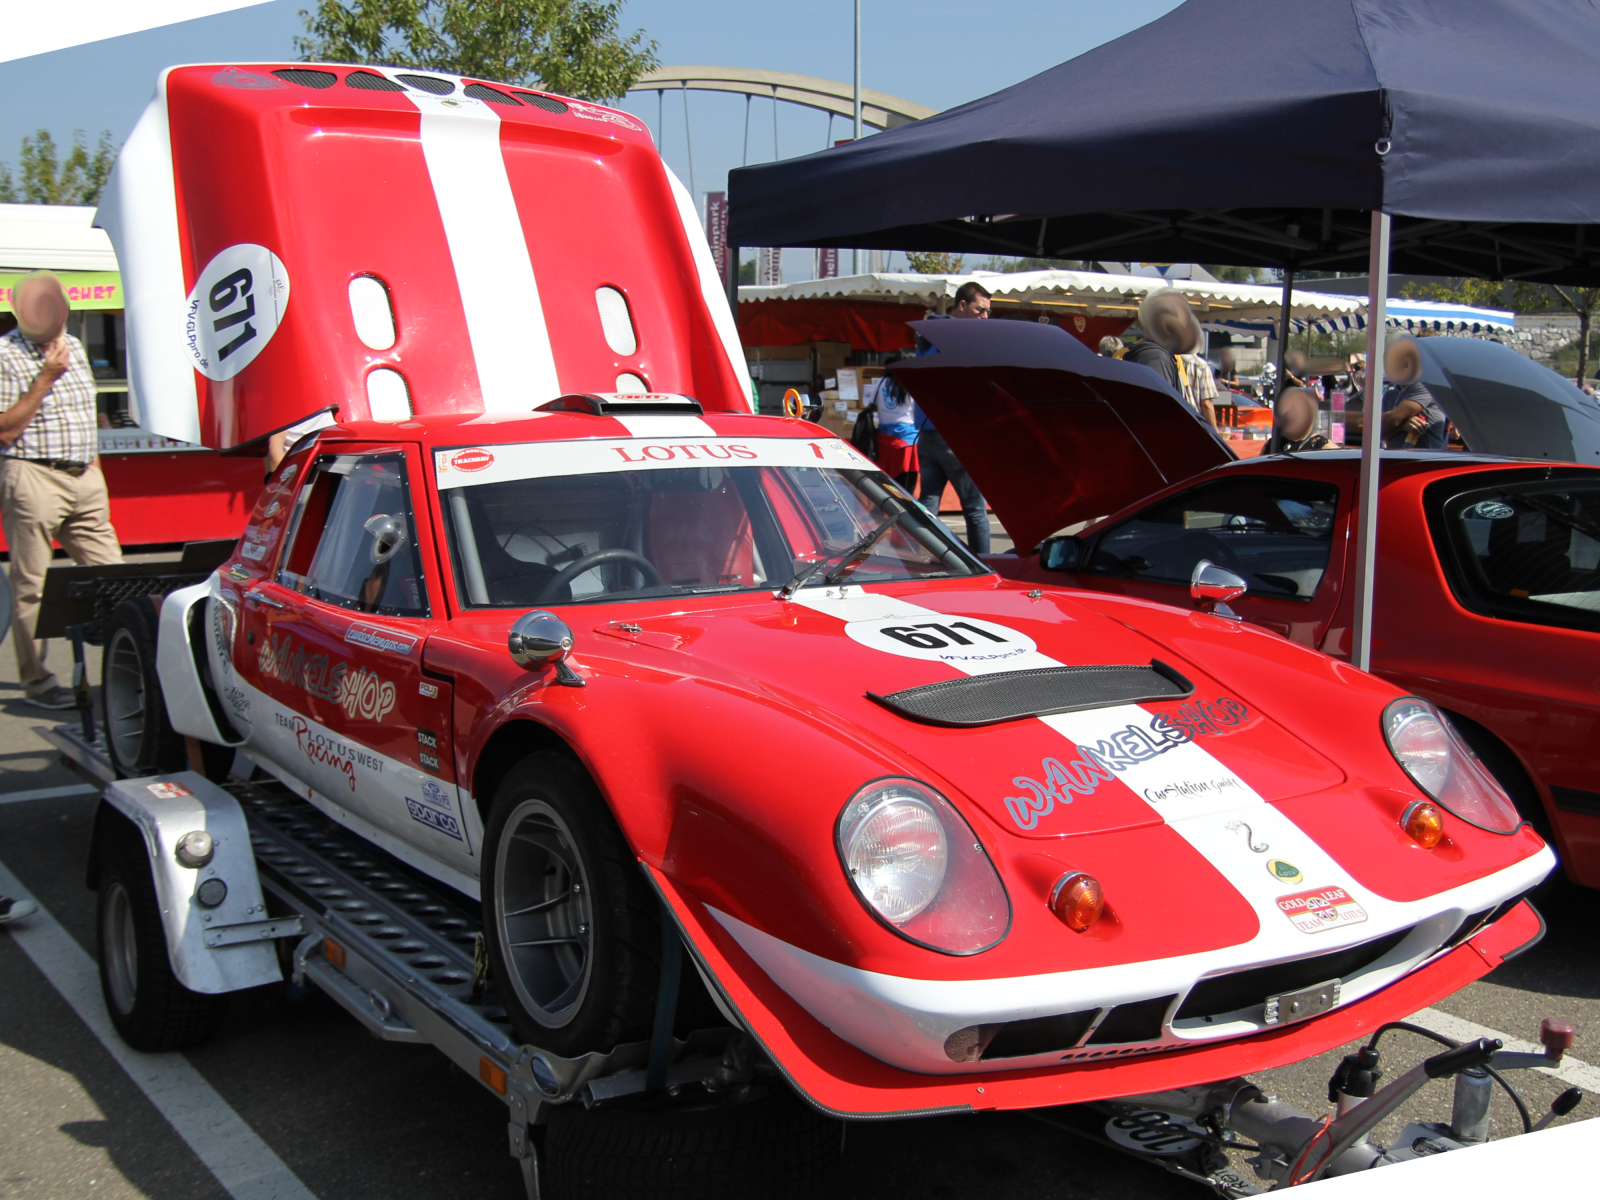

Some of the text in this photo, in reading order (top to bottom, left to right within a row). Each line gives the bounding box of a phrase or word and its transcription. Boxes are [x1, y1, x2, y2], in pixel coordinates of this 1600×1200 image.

[209, 267, 257, 362] 671
[186, 299, 209, 369] VFV-GLPpro.de
[610, 444, 758, 462] LOTUS
[879, 621, 1010, 649] 671
[939, 647, 1027, 660] VFV-GLPpro.de
[275, 712, 384, 773] TEAM LOTUS WEST
[292, 715, 356, 792] Racing
[418, 732, 437, 749] STACK
[419, 752, 439, 770] STACK
[1004, 697, 1251, 830] WANKELSHOP
[407, 799, 459, 835] sparco
[1278, 888, 1346, 911] GOLD LEAF
[1297, 908, 1366, 931] TEAM LOTUS
